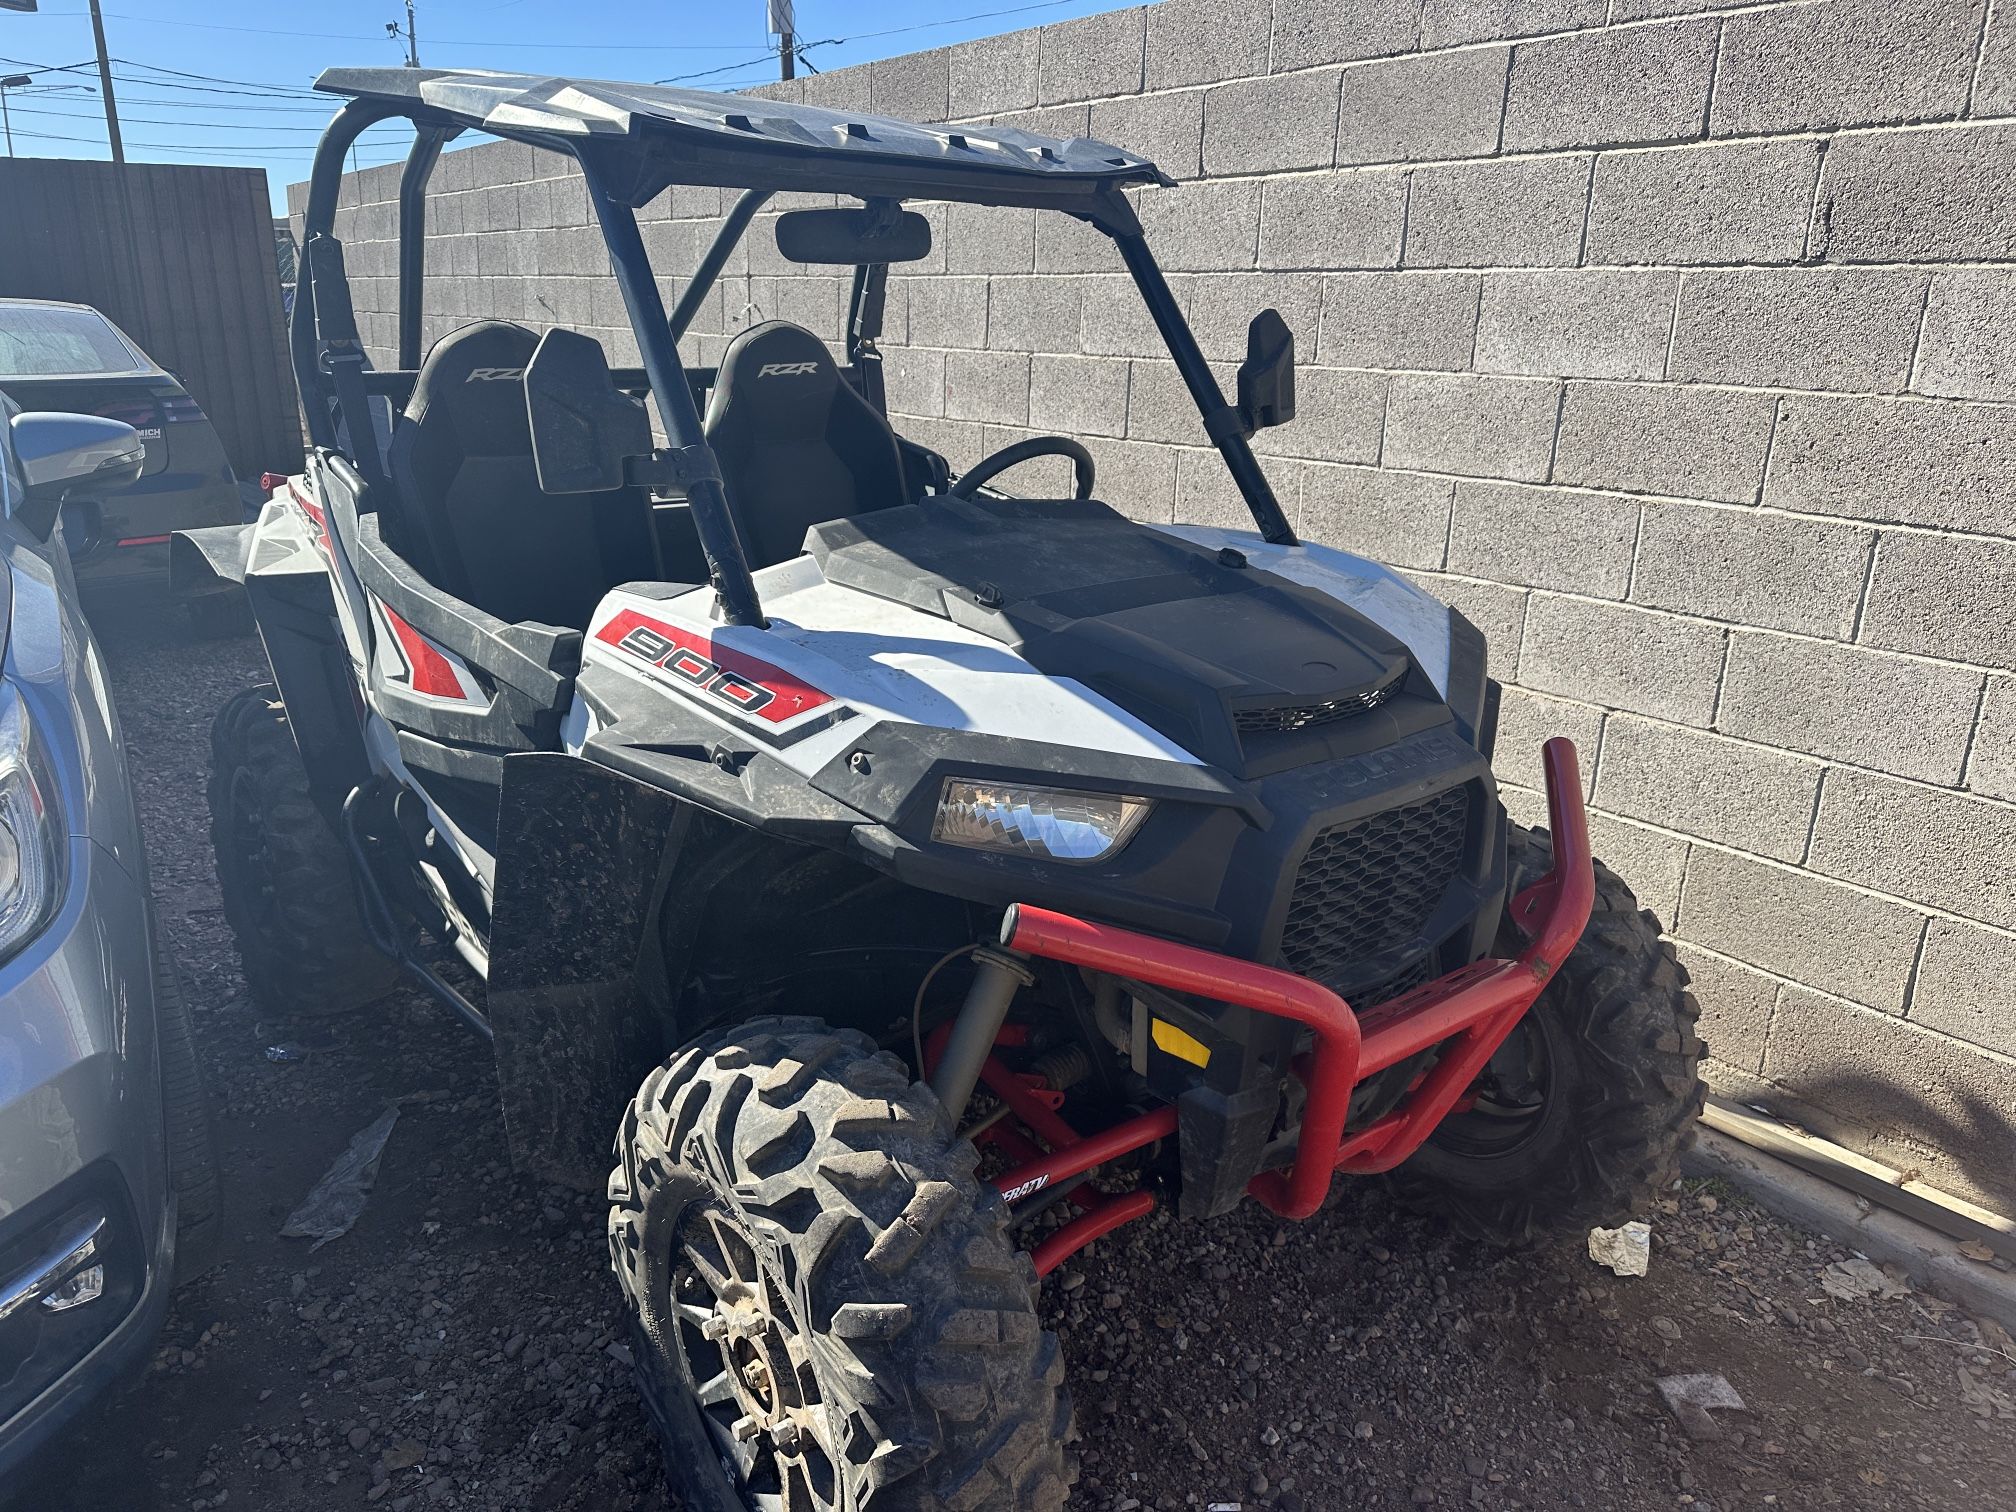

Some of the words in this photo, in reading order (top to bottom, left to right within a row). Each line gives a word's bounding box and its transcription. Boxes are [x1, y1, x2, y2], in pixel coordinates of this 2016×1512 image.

[465, 368, 526, 382] RZ
[758, 362, 818, 378] RZR
[618, 626, 776, 714] 900
[1306, 738, 1457, 797] POLARIS
[1002, 1174, 1049, 1202] ERATV
